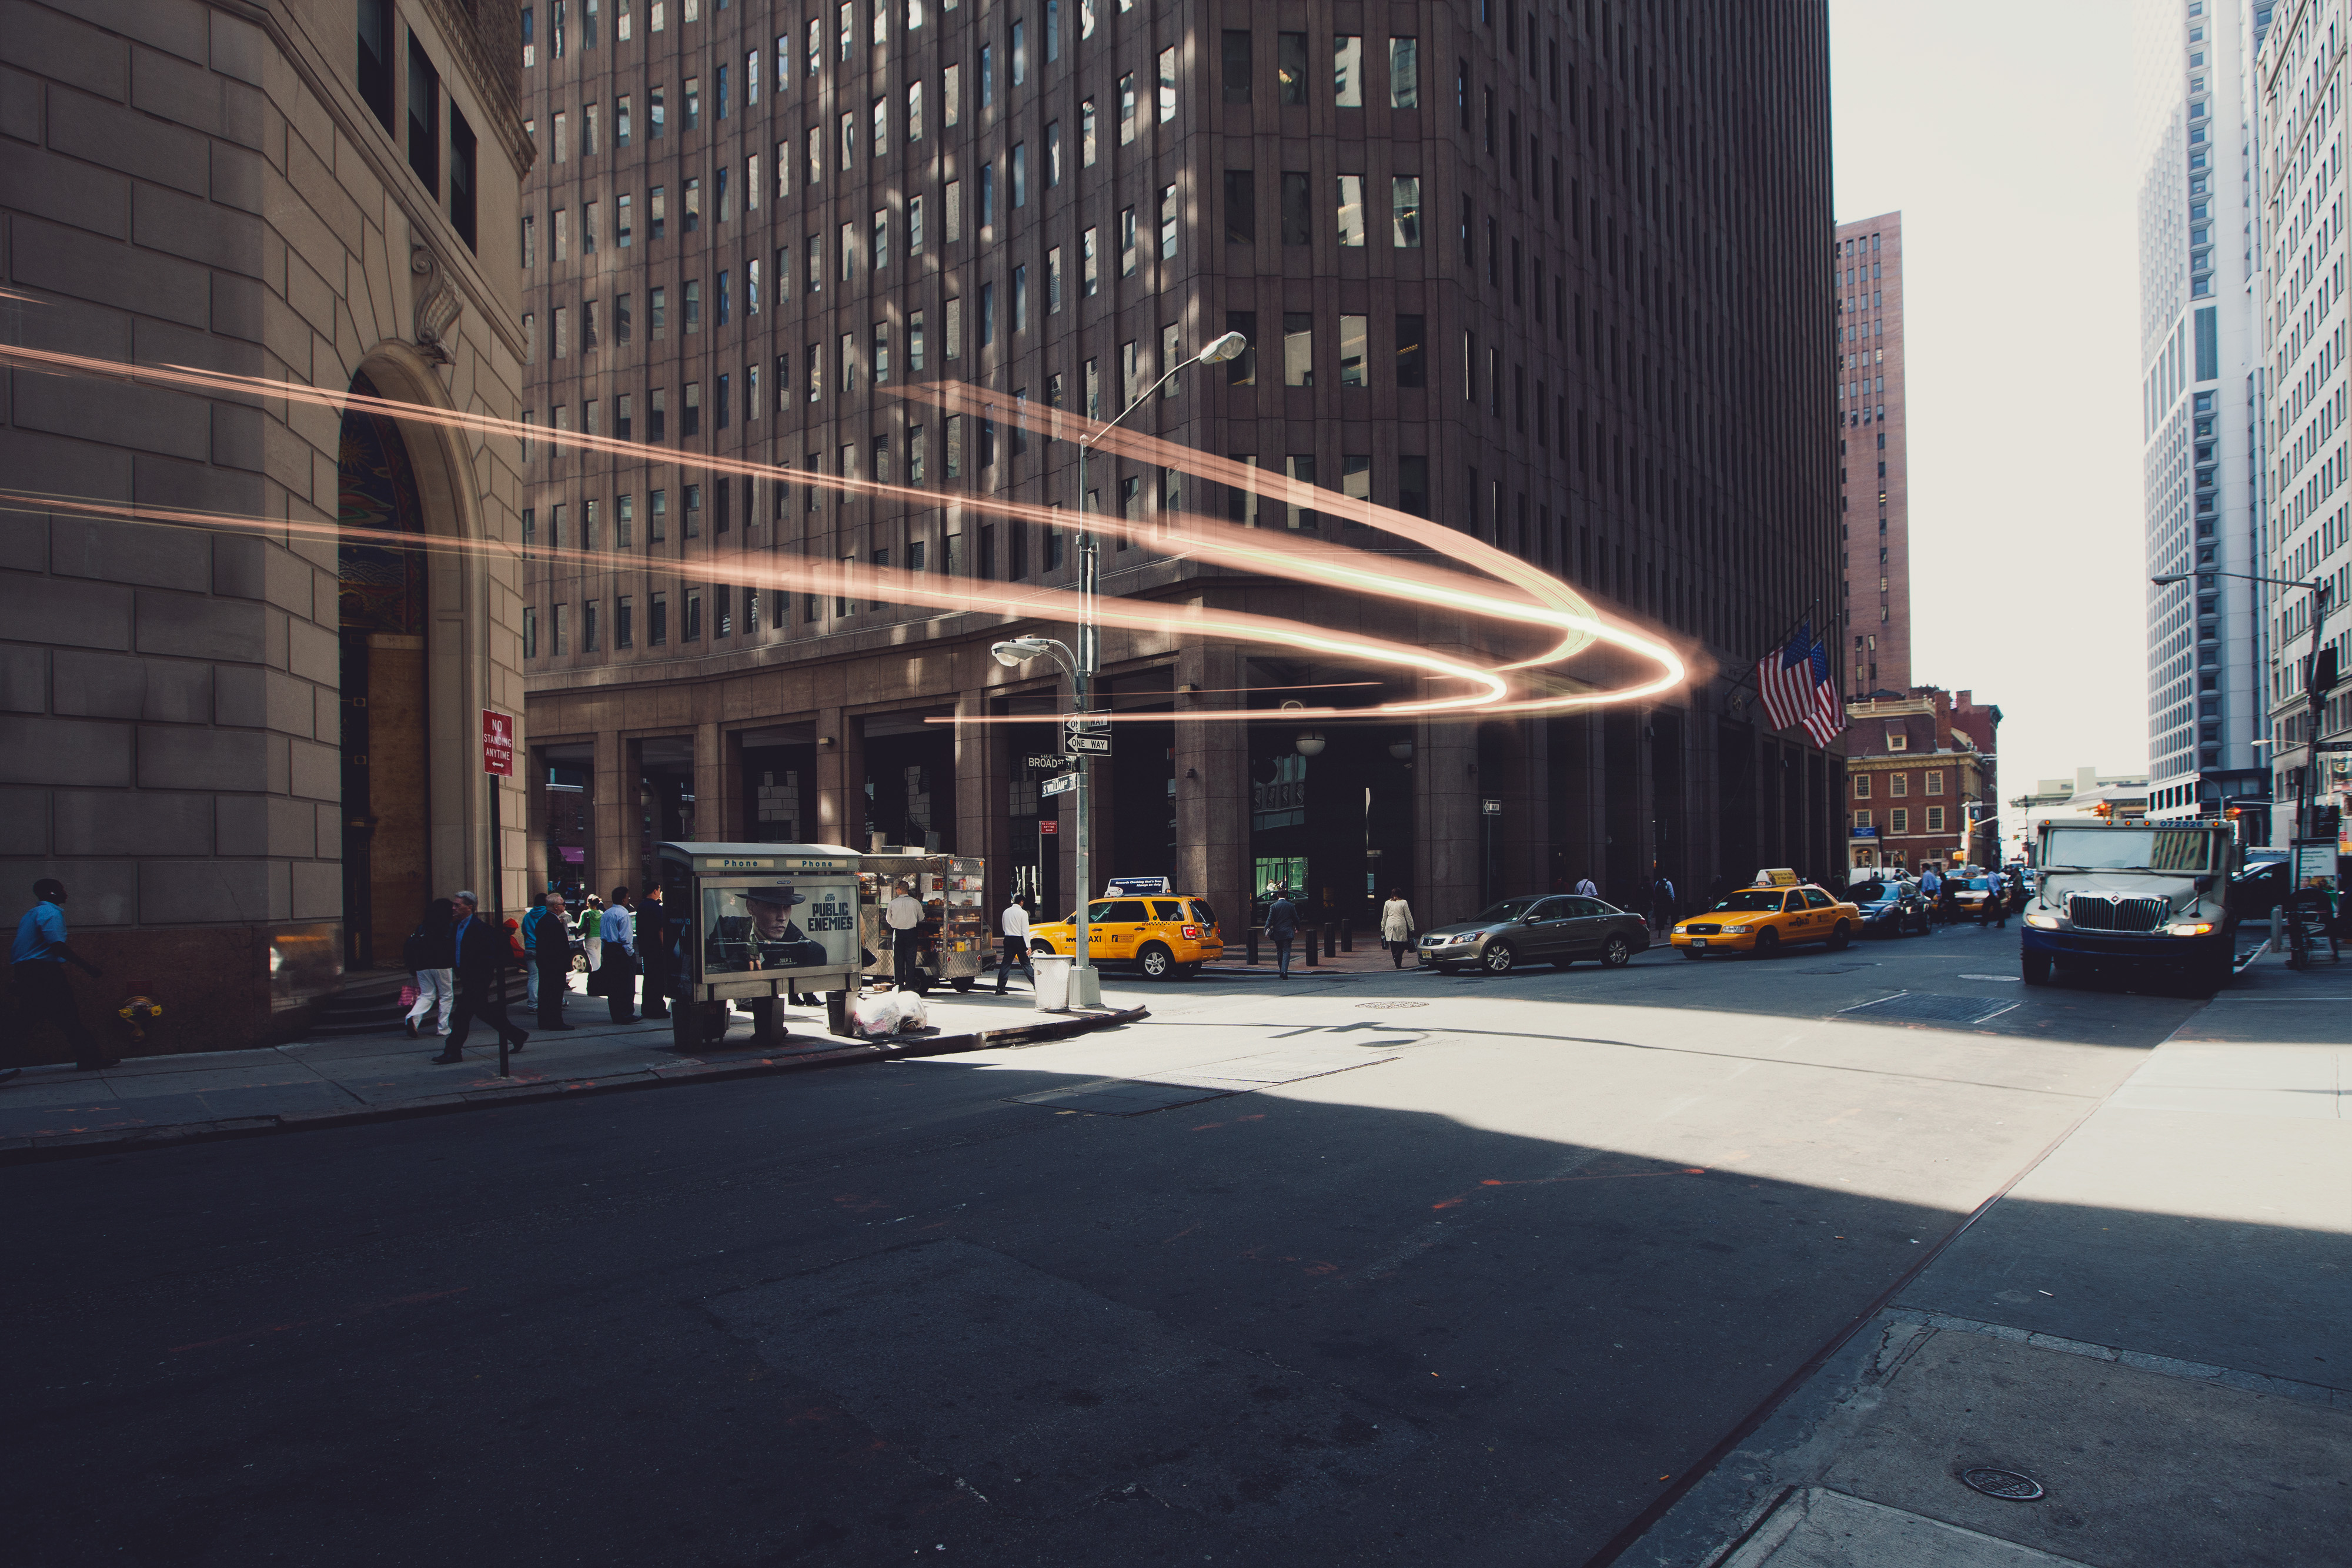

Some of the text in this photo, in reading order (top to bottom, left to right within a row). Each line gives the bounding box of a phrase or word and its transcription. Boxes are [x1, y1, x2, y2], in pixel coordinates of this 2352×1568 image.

[492, 718, 502, 732] NO
[1090, 716, 1105, 726] WAY
[484, 733, 512, 747] STANDING
[1072, 738, 1105, 749] ONE WAY
[486, 747, 510, 760] ANYTIME
[1028, 757, 1057, 768] BROAD
[1043, 785, 1047, 794] S
[1047, 780, 1064, 793] WILLIAM
[812, 902, 848, 917] PUBLIC
[808, 917, 853, 932] ENEMIES
